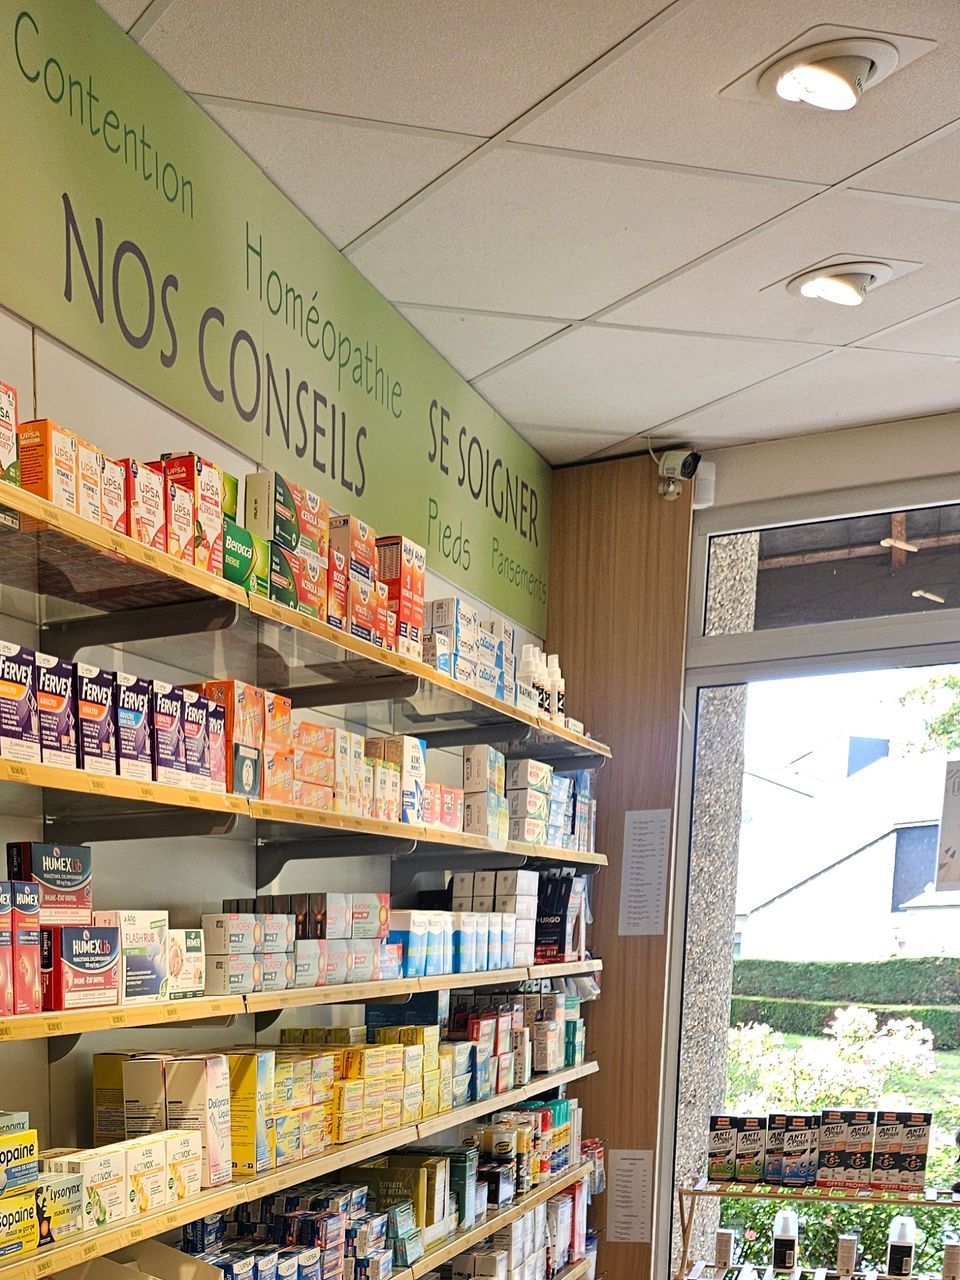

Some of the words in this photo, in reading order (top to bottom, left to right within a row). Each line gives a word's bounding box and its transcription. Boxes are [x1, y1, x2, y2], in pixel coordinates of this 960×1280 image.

[14, 11, 195, 219] Contention
[61, 192, 180, 369] NOS
[198, 307, 368, 497] CONSEILS
[245, 221, 403, 419] Homéopathie
[140, 482, 160, 499] UPSA
[428, 399, 450, 475] SE
[458, 425, 540, 547] SOIGNER
[225, 536, 253, 559] Berocca
[428, 499, 471, 571] Pieds
[490, 537, 548, 606] Pansements
[82, 676, 112, 705] FERVEX
[713, 1132, 731, 1140] ANTI
[50, 1184, 82, 1201] Lysorynx
